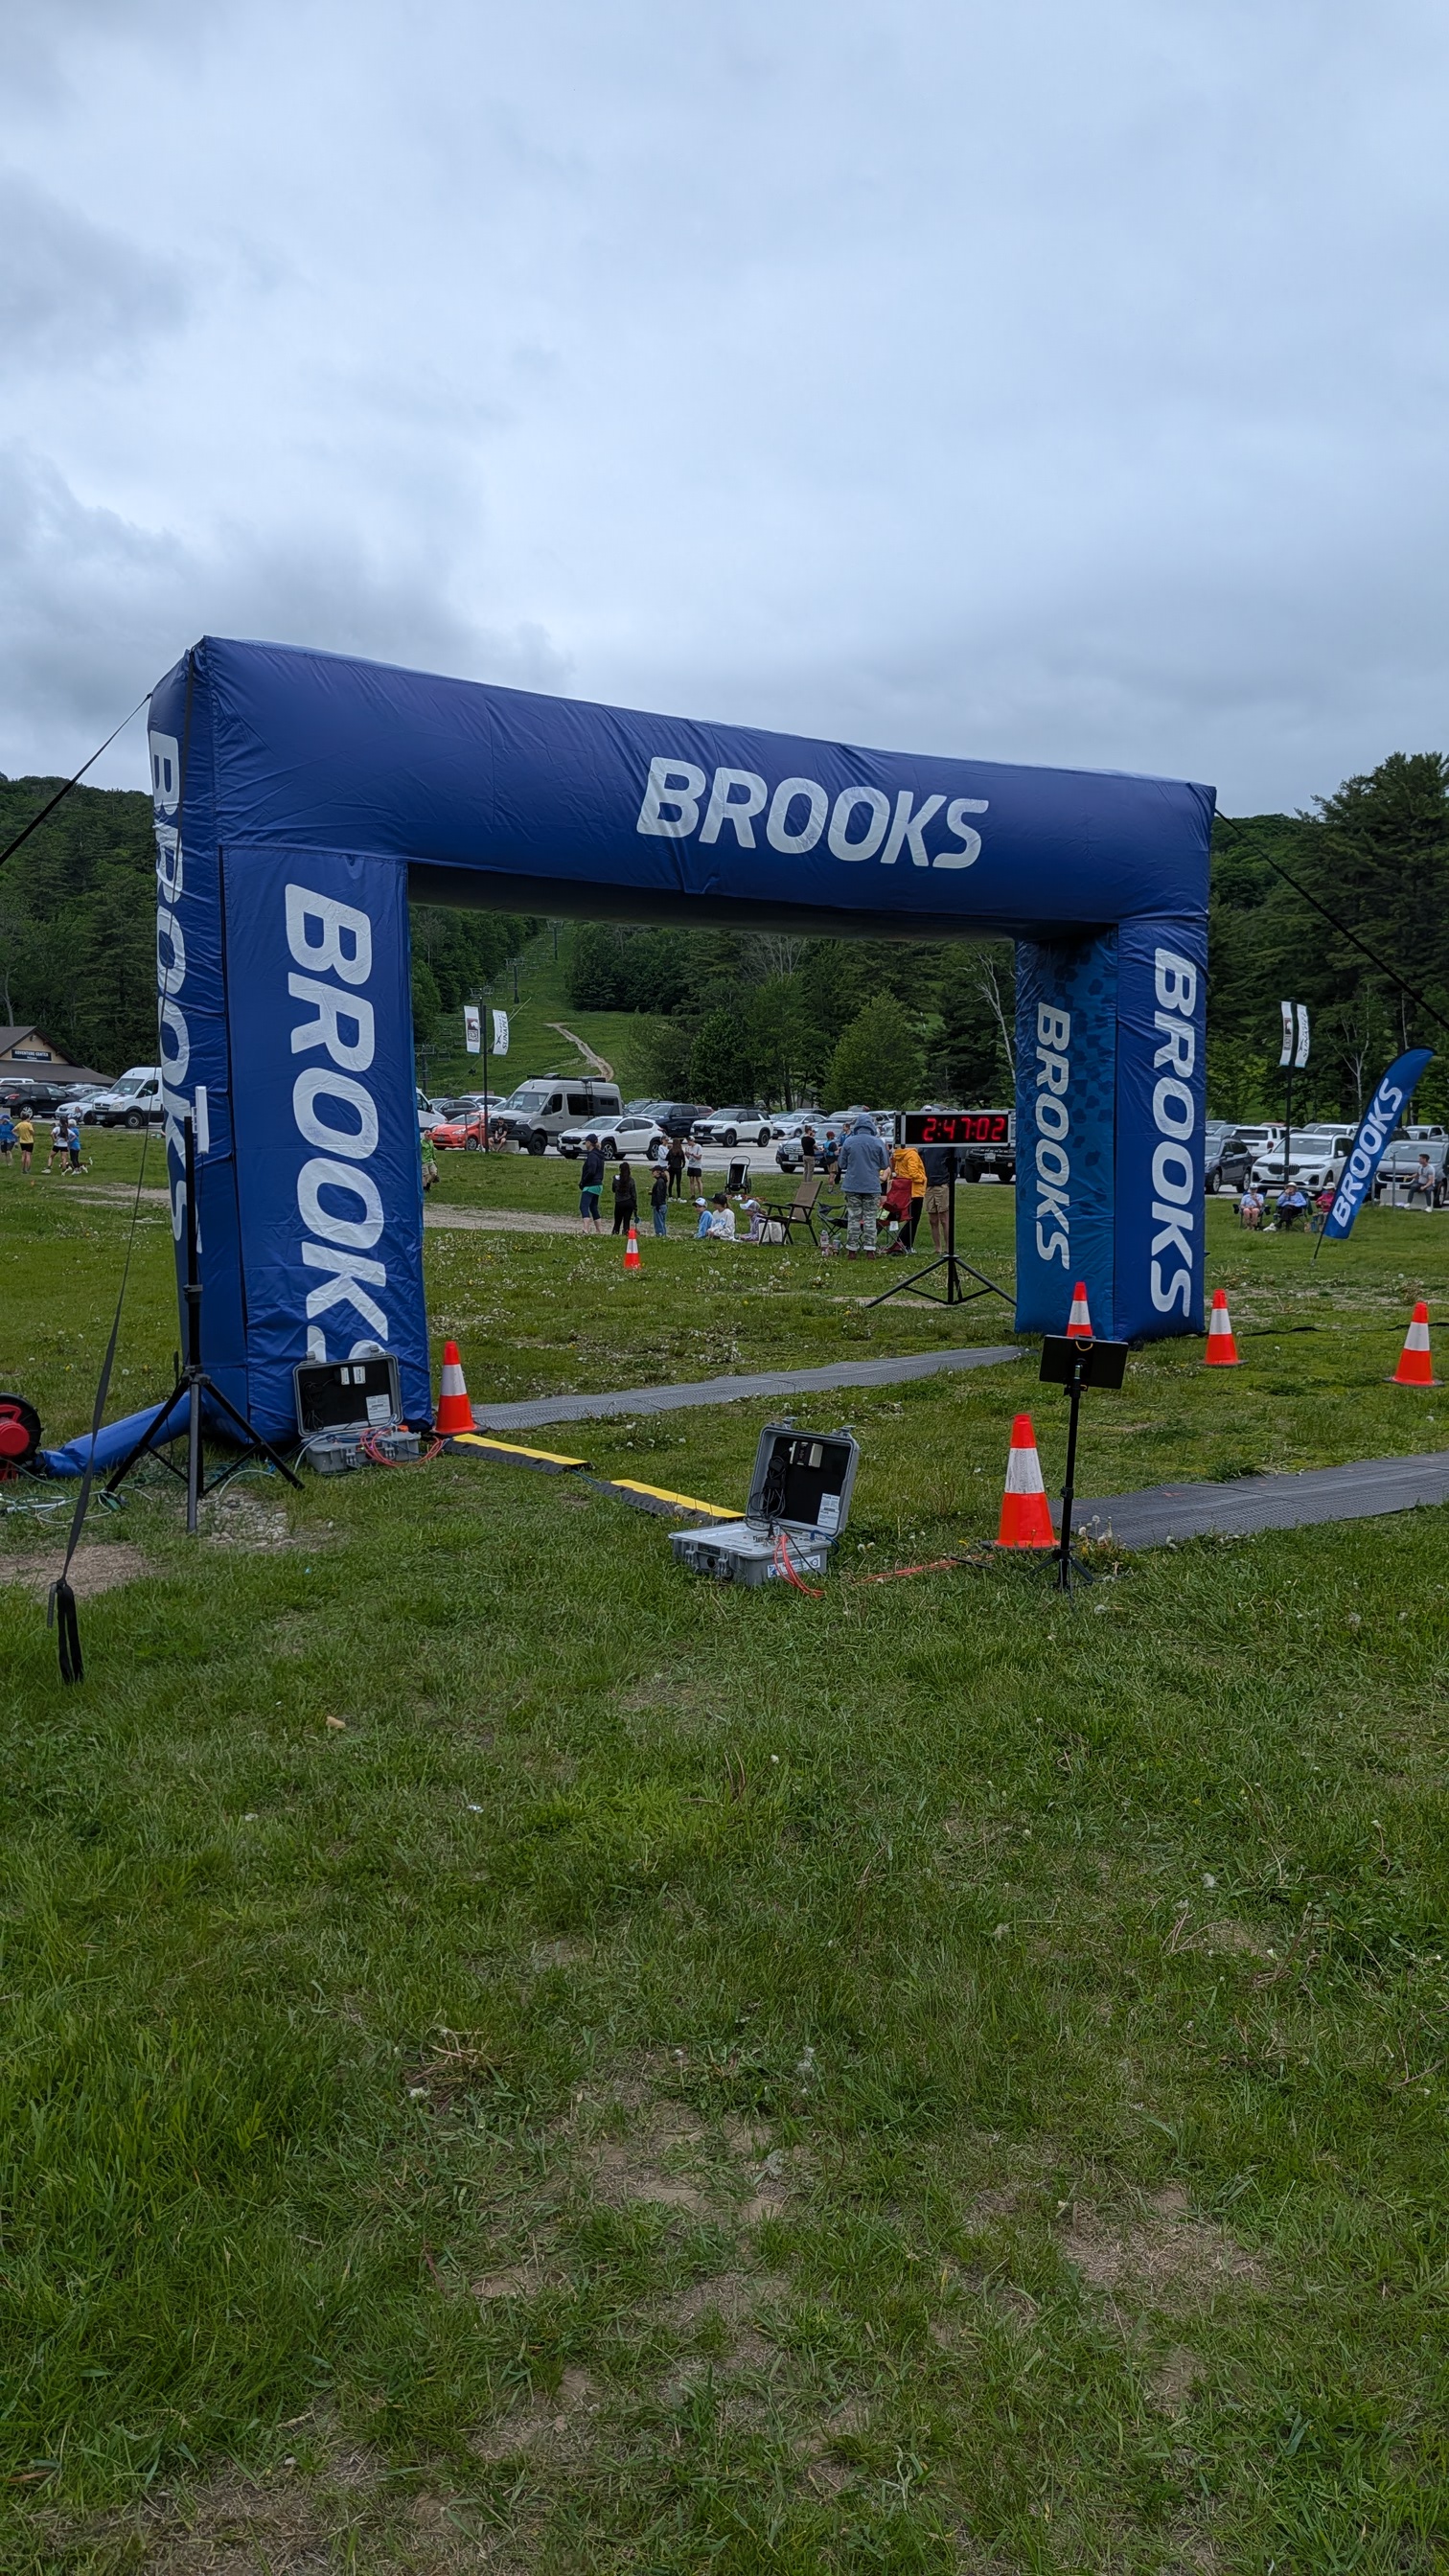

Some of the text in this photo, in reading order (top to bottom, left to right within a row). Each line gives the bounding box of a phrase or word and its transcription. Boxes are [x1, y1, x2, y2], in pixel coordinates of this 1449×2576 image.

[636, 756, 989, 869] BROOKS
[922, 1117, 1005, 1141] 2:47:02
[1036, 1001, 1071, 1271] BROOKS
[1151, 947, 1197, 1318] BROOKS
[1332, 1077, 1403, 1228] BROOKS
